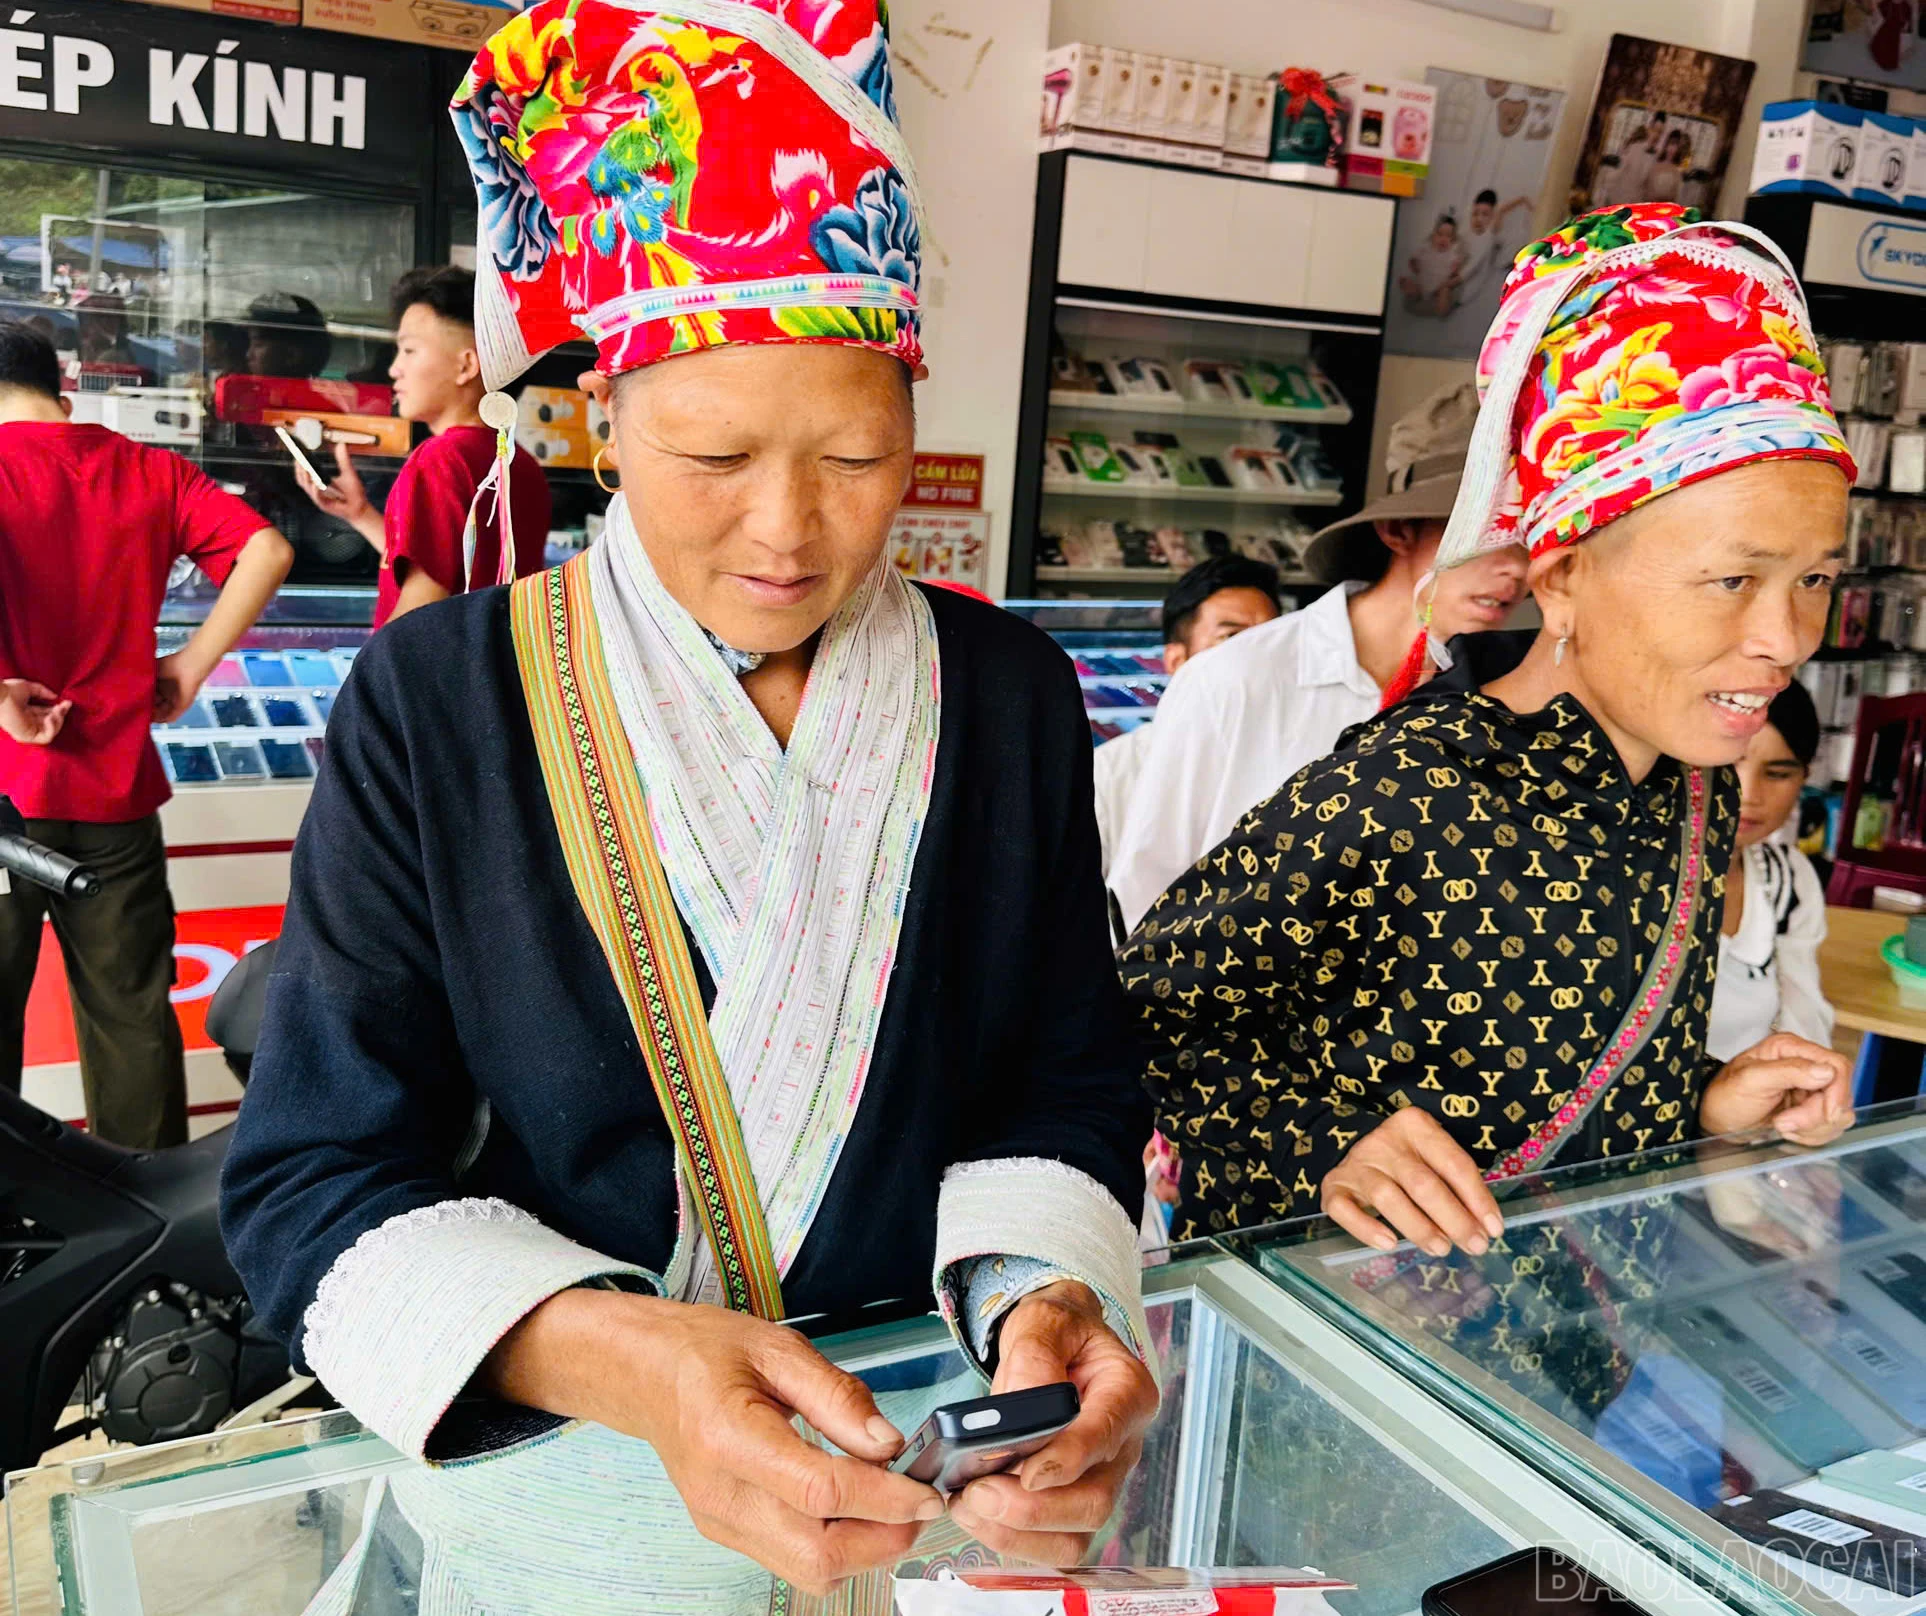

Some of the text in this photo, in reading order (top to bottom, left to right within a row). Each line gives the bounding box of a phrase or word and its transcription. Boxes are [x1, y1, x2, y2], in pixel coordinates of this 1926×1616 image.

[0, 10, 367, 150] ÉP KÍNH
[916, 486, 975, 502] NO FIRE
